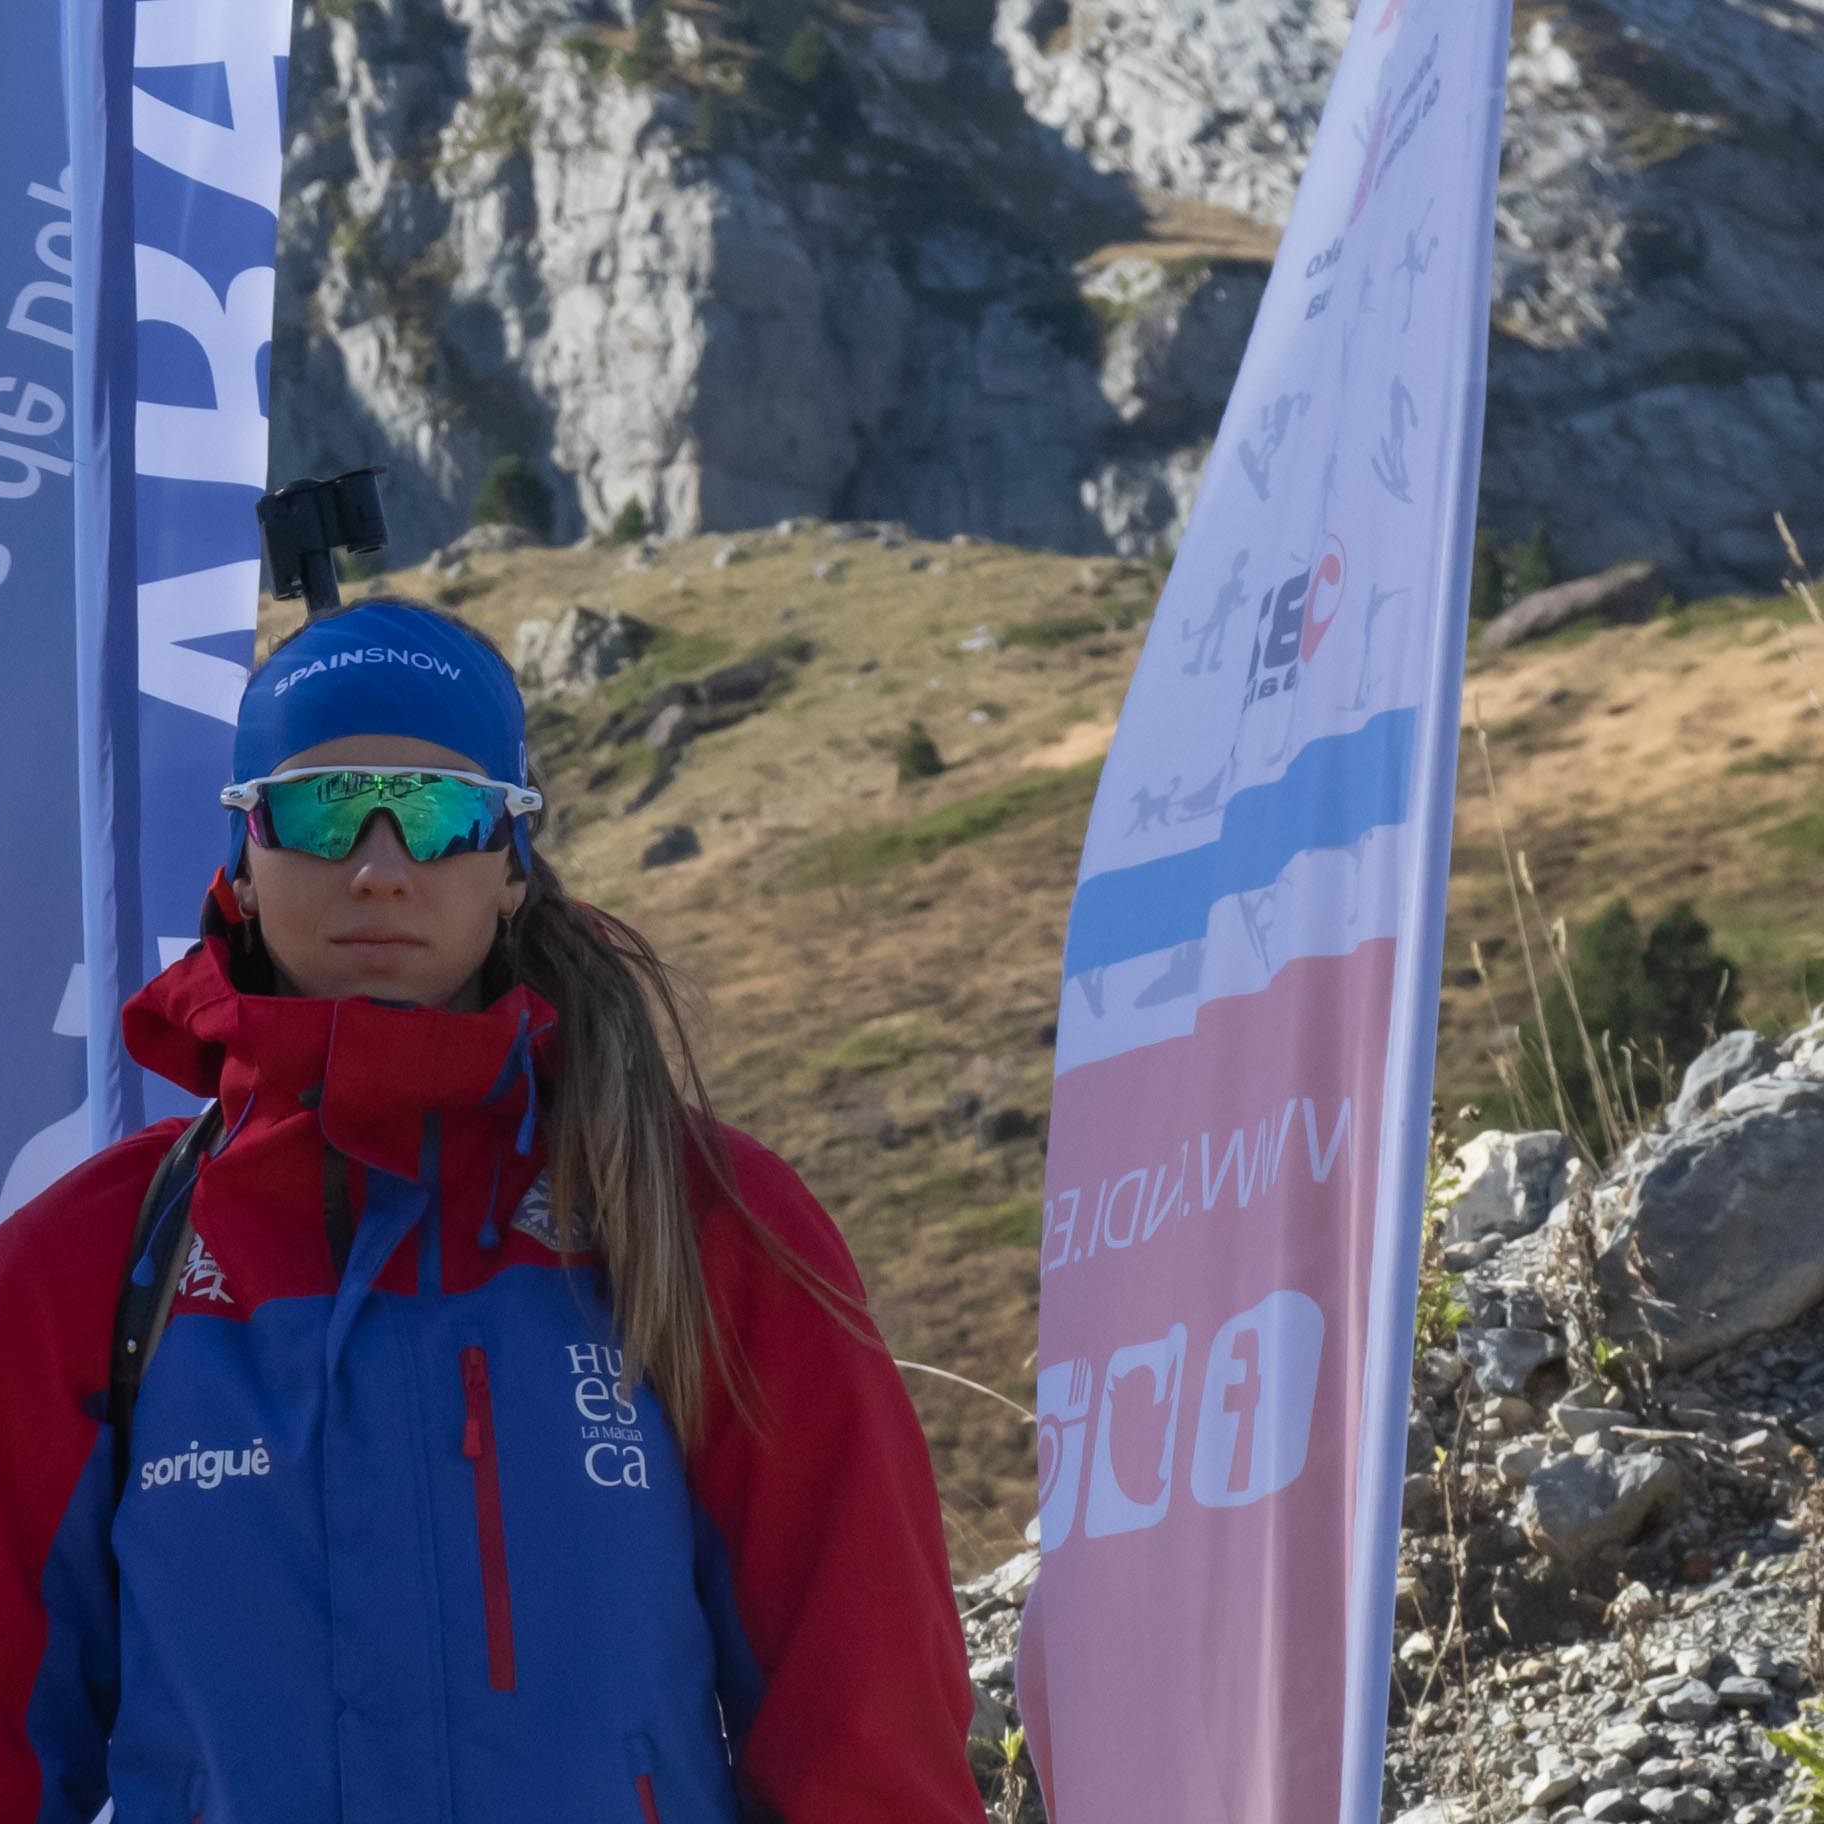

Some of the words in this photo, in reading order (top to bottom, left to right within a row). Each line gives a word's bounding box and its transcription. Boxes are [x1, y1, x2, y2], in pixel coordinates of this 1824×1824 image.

[273, 647, 462, 698] SPAINSNOW
[575, 1376, 637, 1425] es
[584, 1442, 651, 1489] ca
